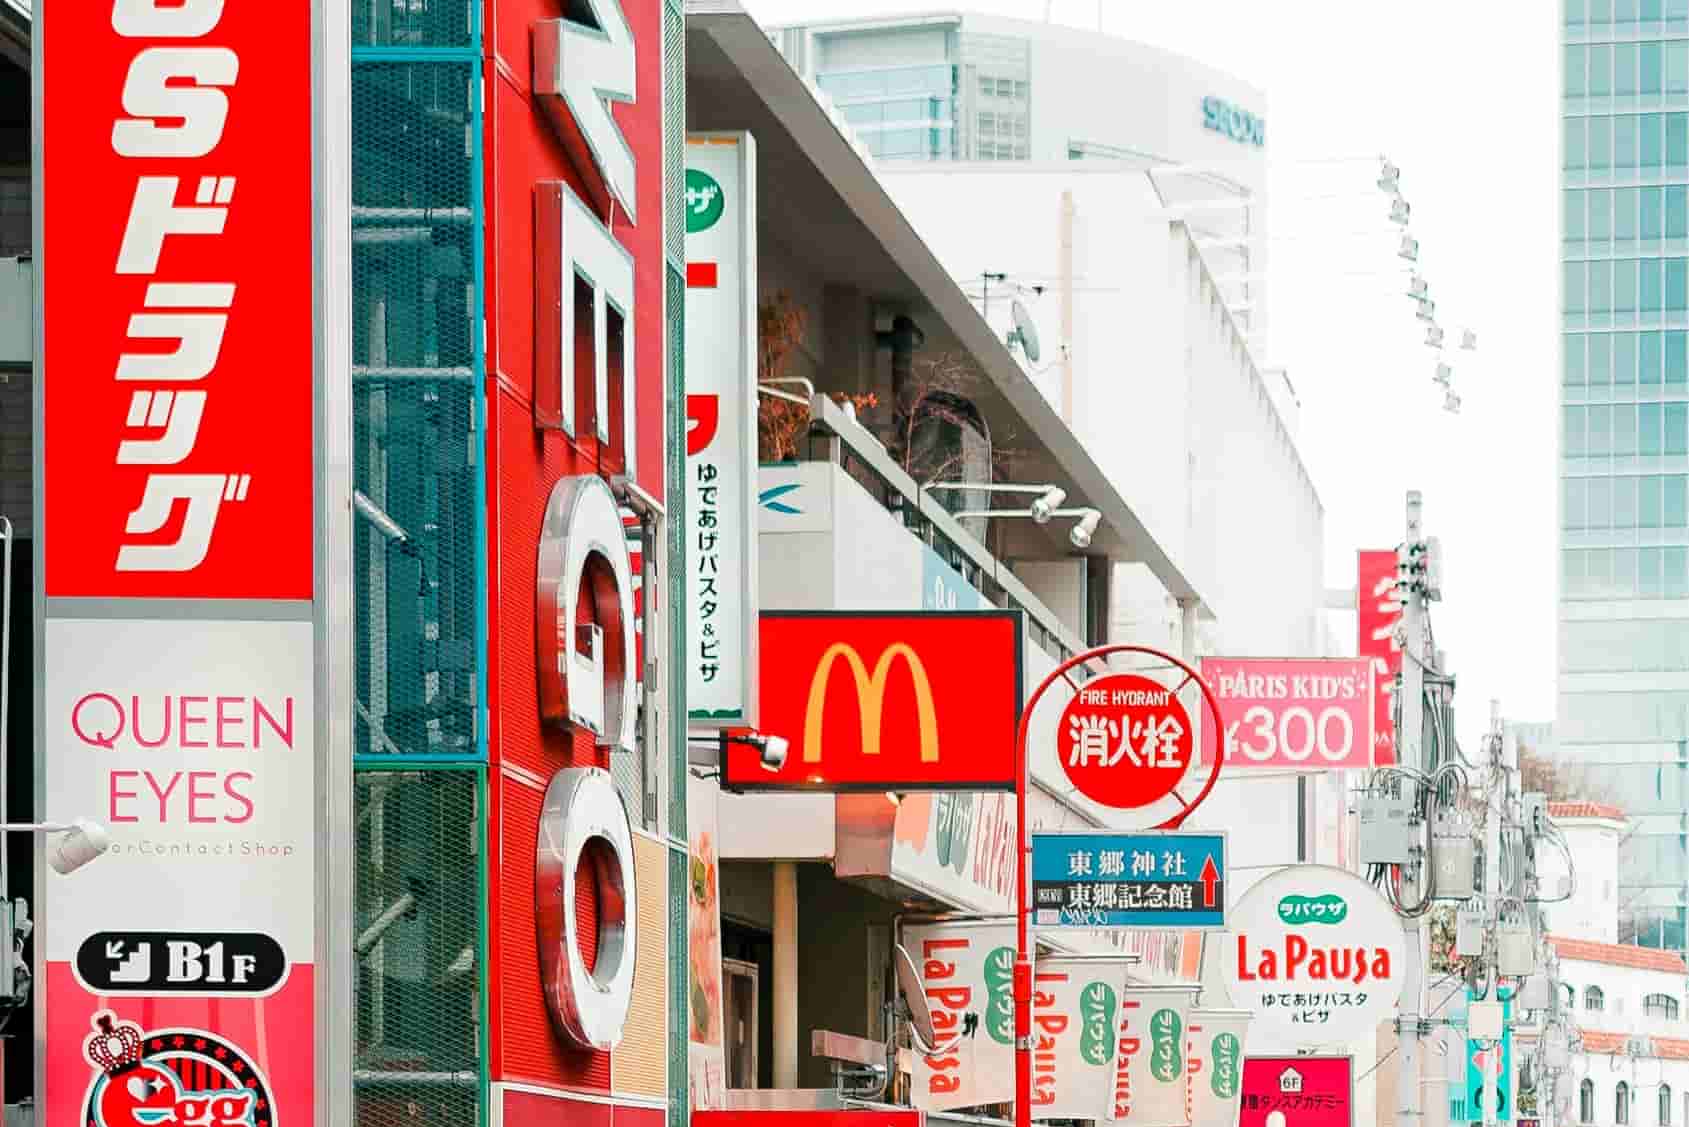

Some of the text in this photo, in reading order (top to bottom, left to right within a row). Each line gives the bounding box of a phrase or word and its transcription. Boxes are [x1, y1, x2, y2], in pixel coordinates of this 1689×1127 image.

[1079, 690, 1170, 706] FIRE HYDRANT
[1221, 672, 1356, 699] PARIS KID'S
[72, 692, 295, 750] QUEEN
[1223, 706, 1354, 761] ¥300
[1067, 714, 1185, 768] 消火栓
[109, 770, 254, 823] EYES
[1067, 850, 1187, 877] 東郷神社
[1067, 883, 1193, 909] 東郷記念館
[1279, 901, 1345, 918] ラパウザ
[166, 940, 257, 984] B1F
[1237, 934, 1391, 984] La Pausa
[1282, 1077, 1300, 1089] 6F
